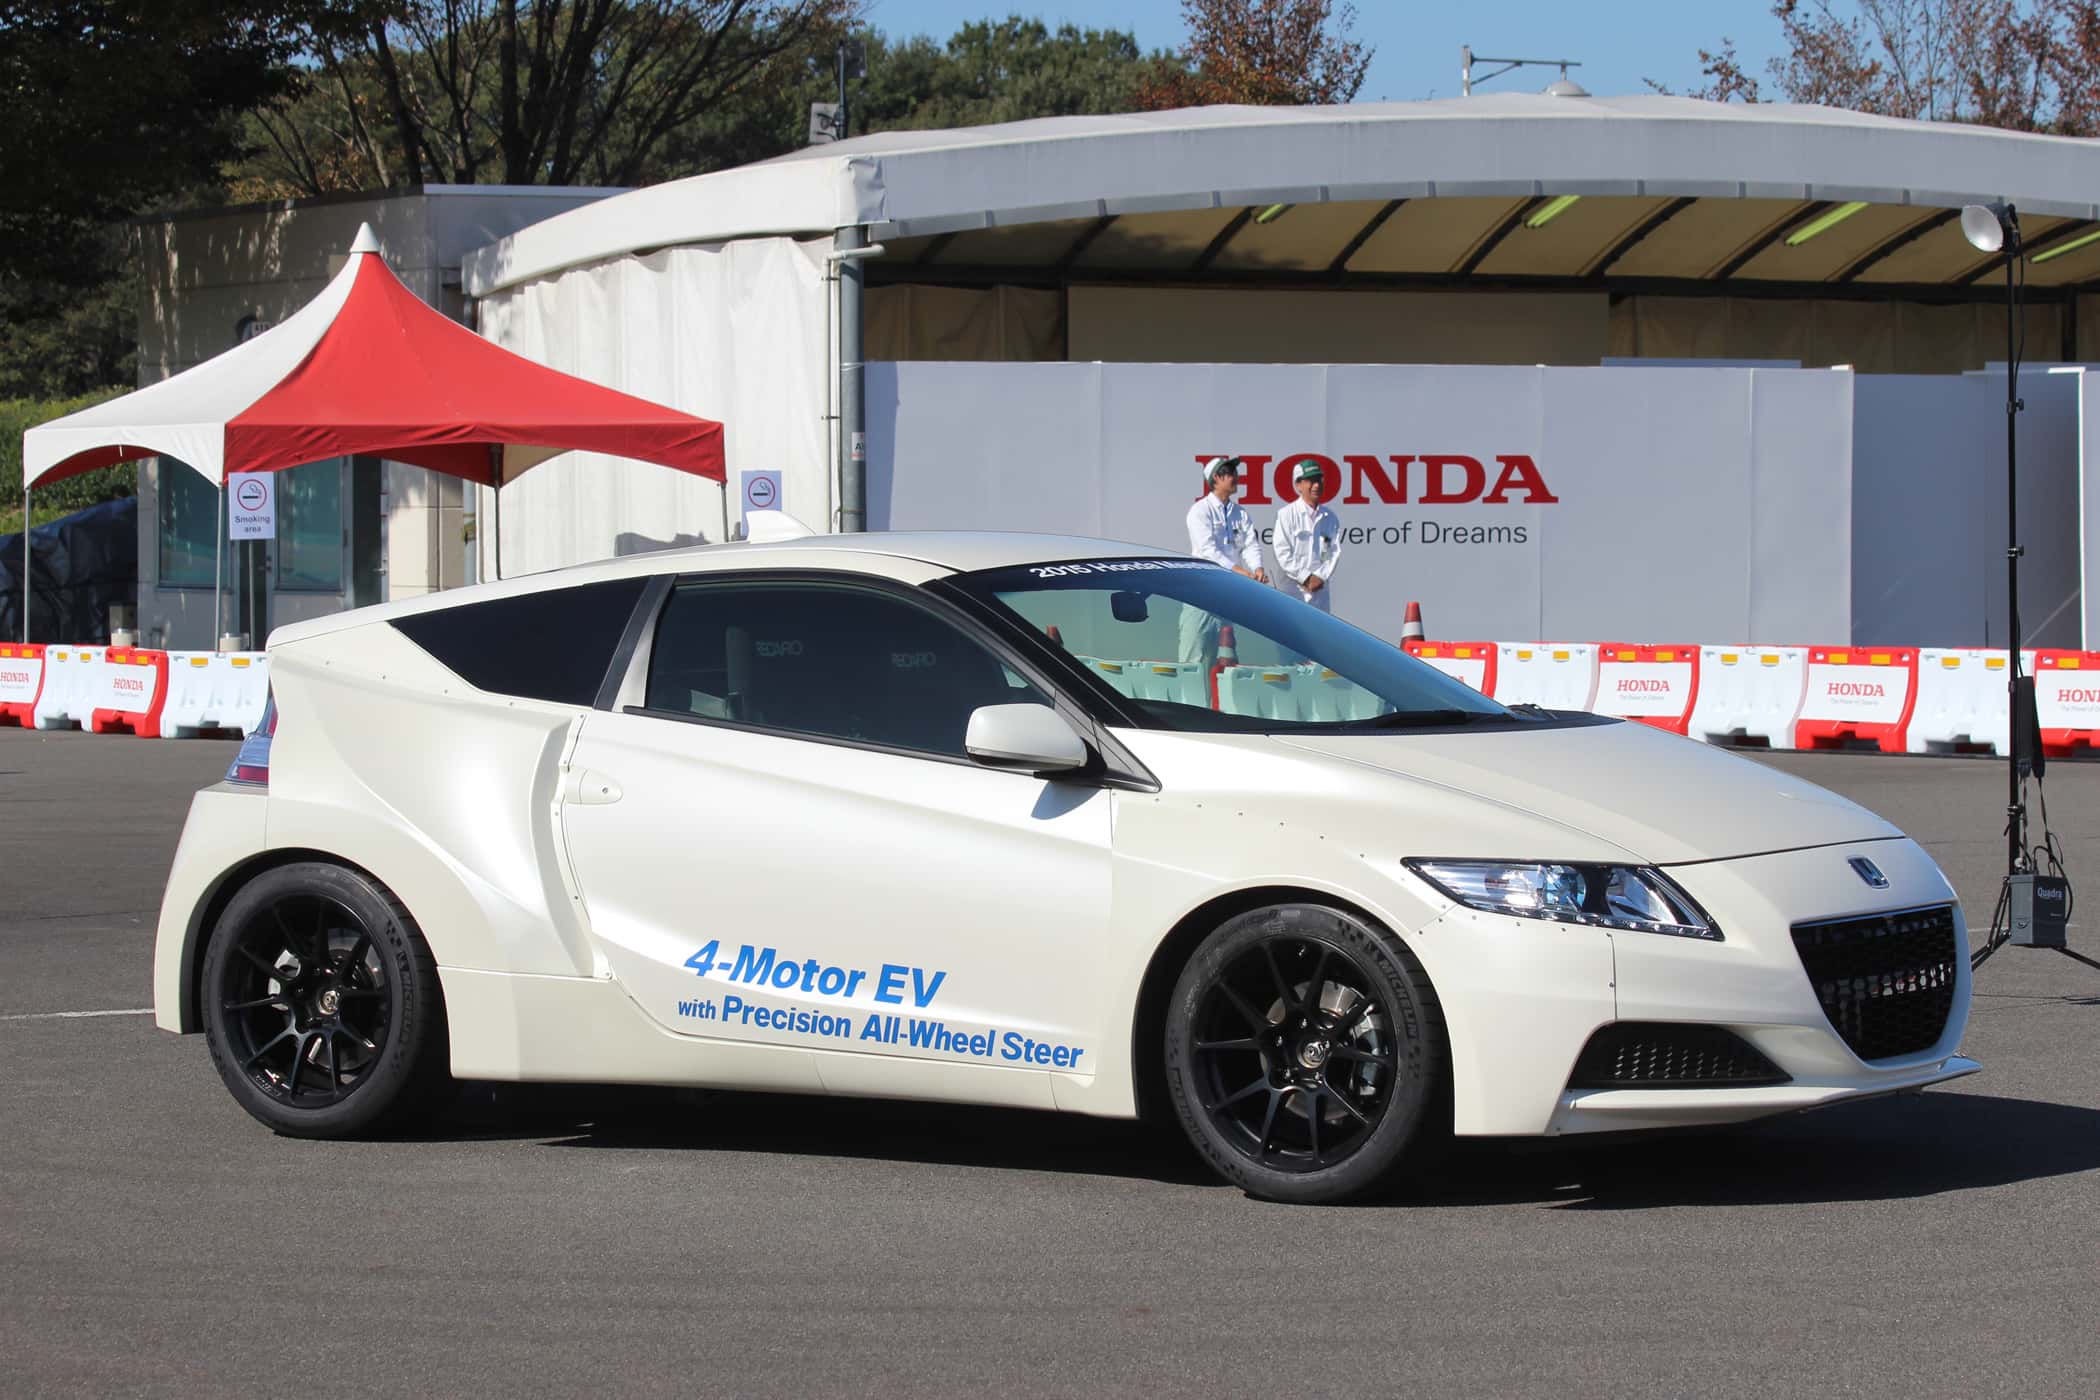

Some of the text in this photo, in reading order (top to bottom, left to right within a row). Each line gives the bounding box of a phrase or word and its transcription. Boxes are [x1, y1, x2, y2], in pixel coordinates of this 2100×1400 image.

[1195, 453, 1558, 505] HONDA
[235, 515, 271, 524] Smoking
[1382, 520, 1412, 545] of
[1421, 521, 1528, 545] Dreams
[1029, 563, 1092, 578] 2015
[0, 671, 29, 683] HONDA
[113, 678, 144, 691] HONDA
[1616, 679, 1671, 692] HONDA
[1828, 682, 1885, 696] HONDA
[2058, 688, 2100, 703] HON
[684, 939, 947, 1009] 4-Motor EV
[678, 995, 1085, 1069] with Precision All-Wheel Steer
